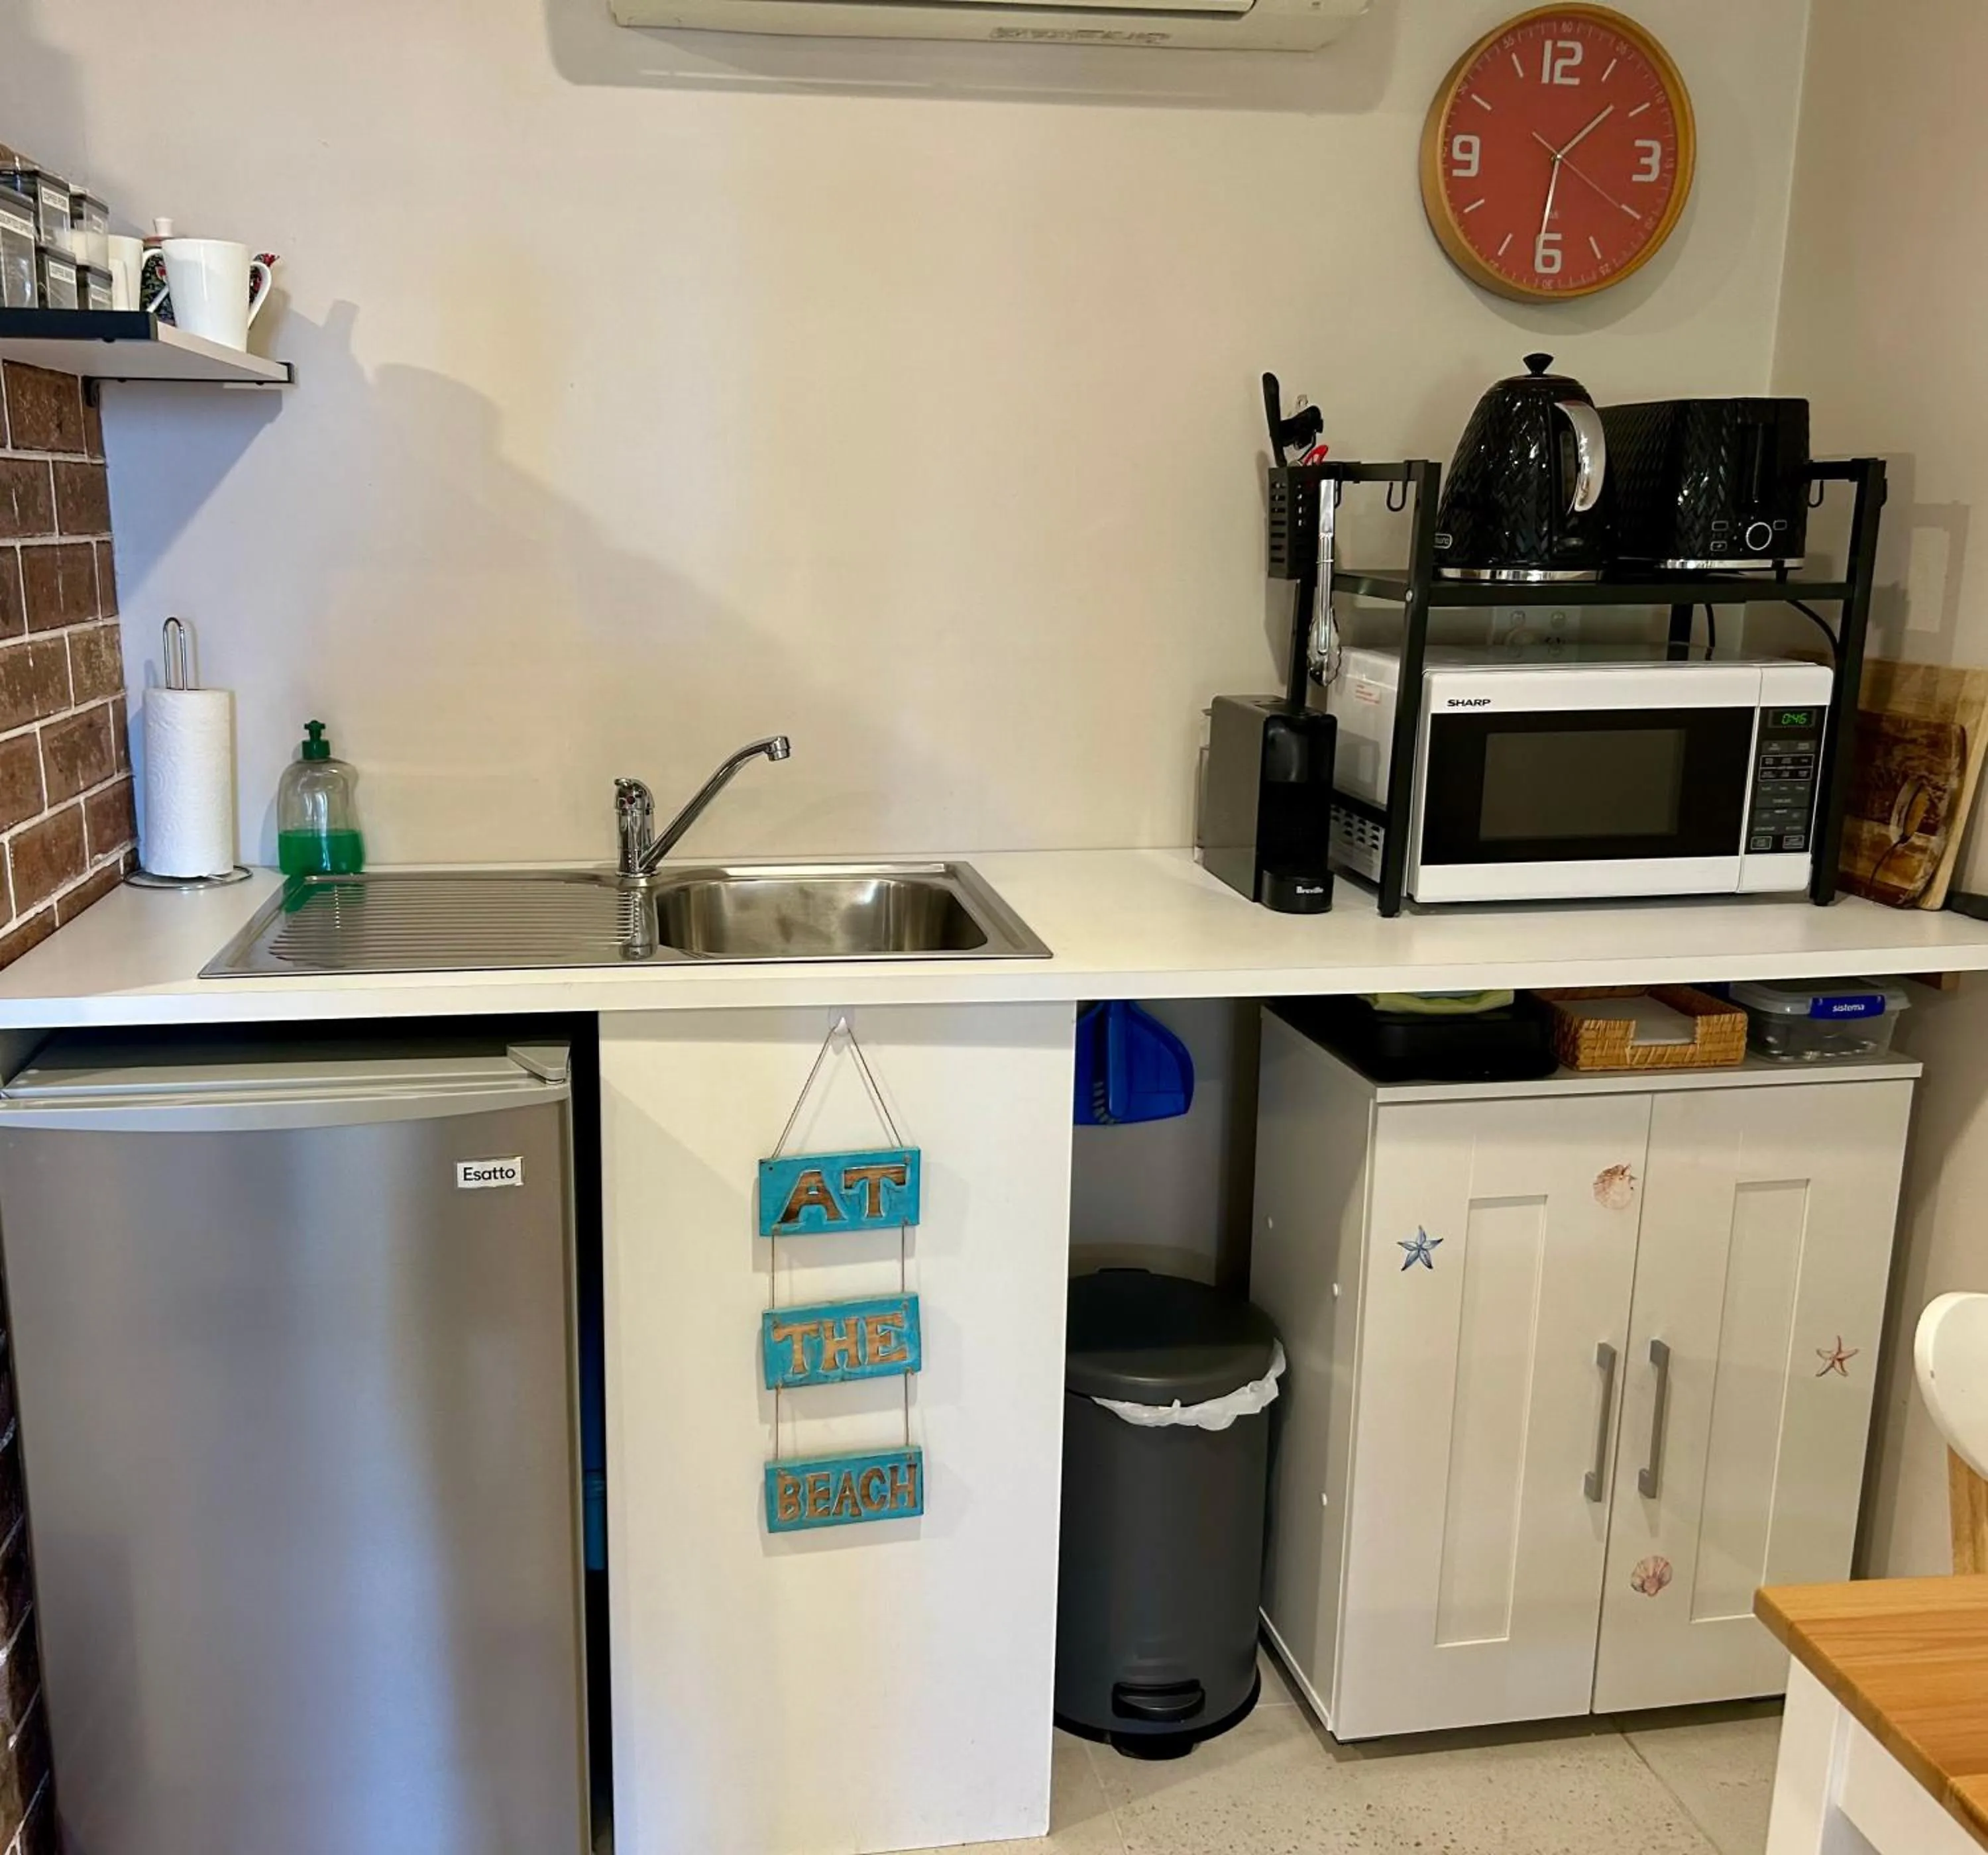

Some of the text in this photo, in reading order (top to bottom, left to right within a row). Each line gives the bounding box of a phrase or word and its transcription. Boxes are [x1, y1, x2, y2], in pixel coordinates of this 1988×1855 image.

[1541, 39, 1584, 85] 12
[1452, 134, 1480, 178] 9
[1632, 140, 1661, 182] 3
[1534, 233, 1563, 274] 6
[1832, 1003, 1865, 1013] sistema
[463, 1167, 516, 1181] Esatto
[777, 1164, 907, 1224] AT
[773, 1312, 909, 1374] THE
[777, 1463, 917, 1522] BEACH
